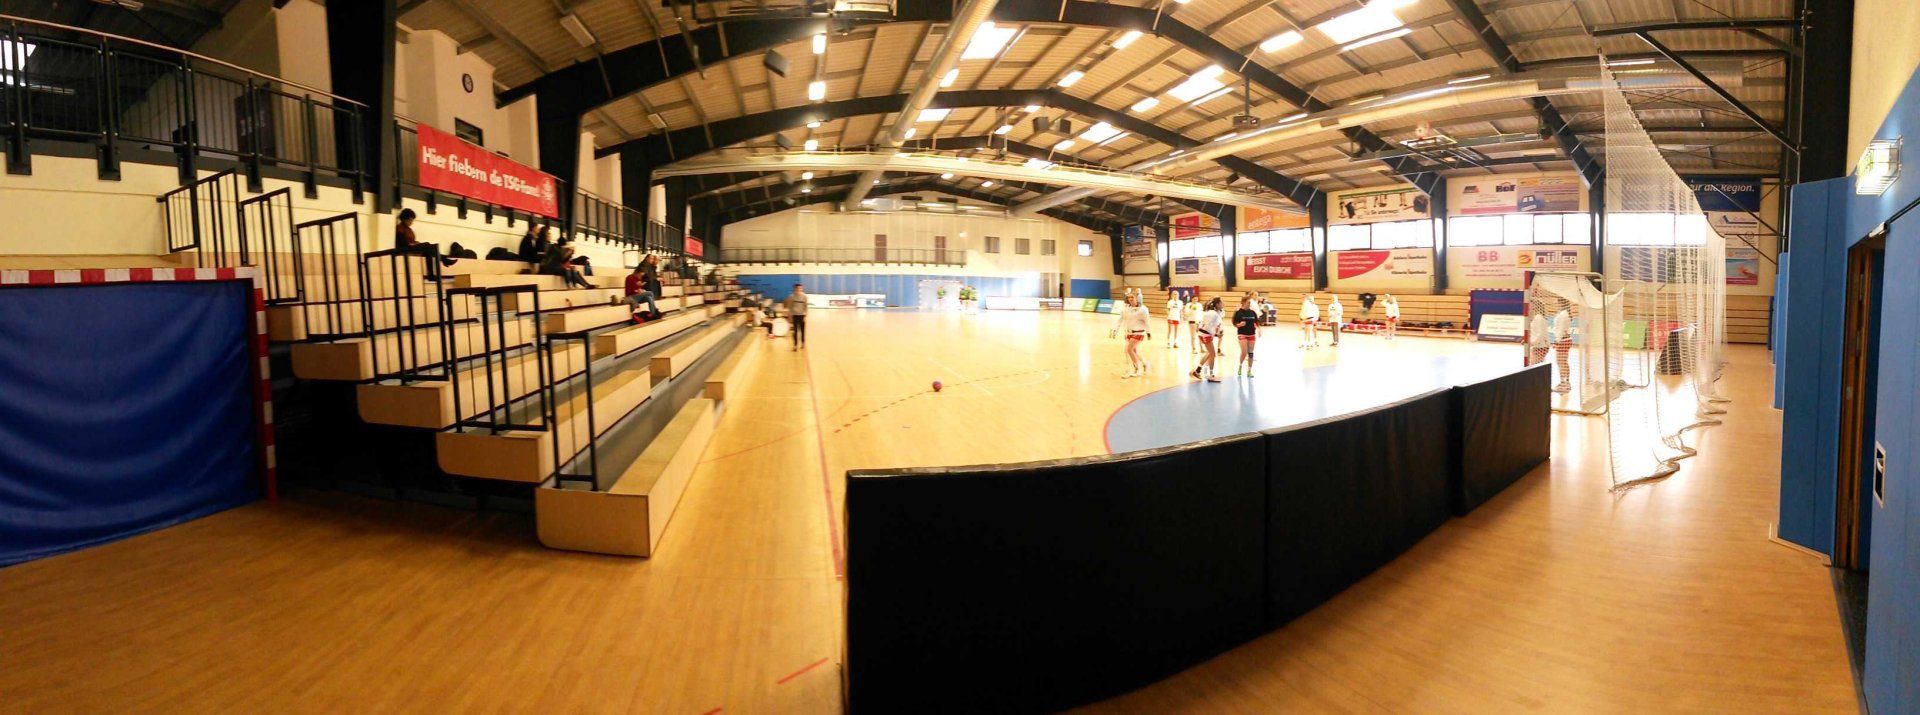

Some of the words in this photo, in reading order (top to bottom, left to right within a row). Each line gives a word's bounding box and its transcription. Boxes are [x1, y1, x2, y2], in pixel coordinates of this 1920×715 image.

[422, 145, 447, 169] Hier
[448, 154, 488, 182] fiebern
[1478, 250, 1499, 262] BB
